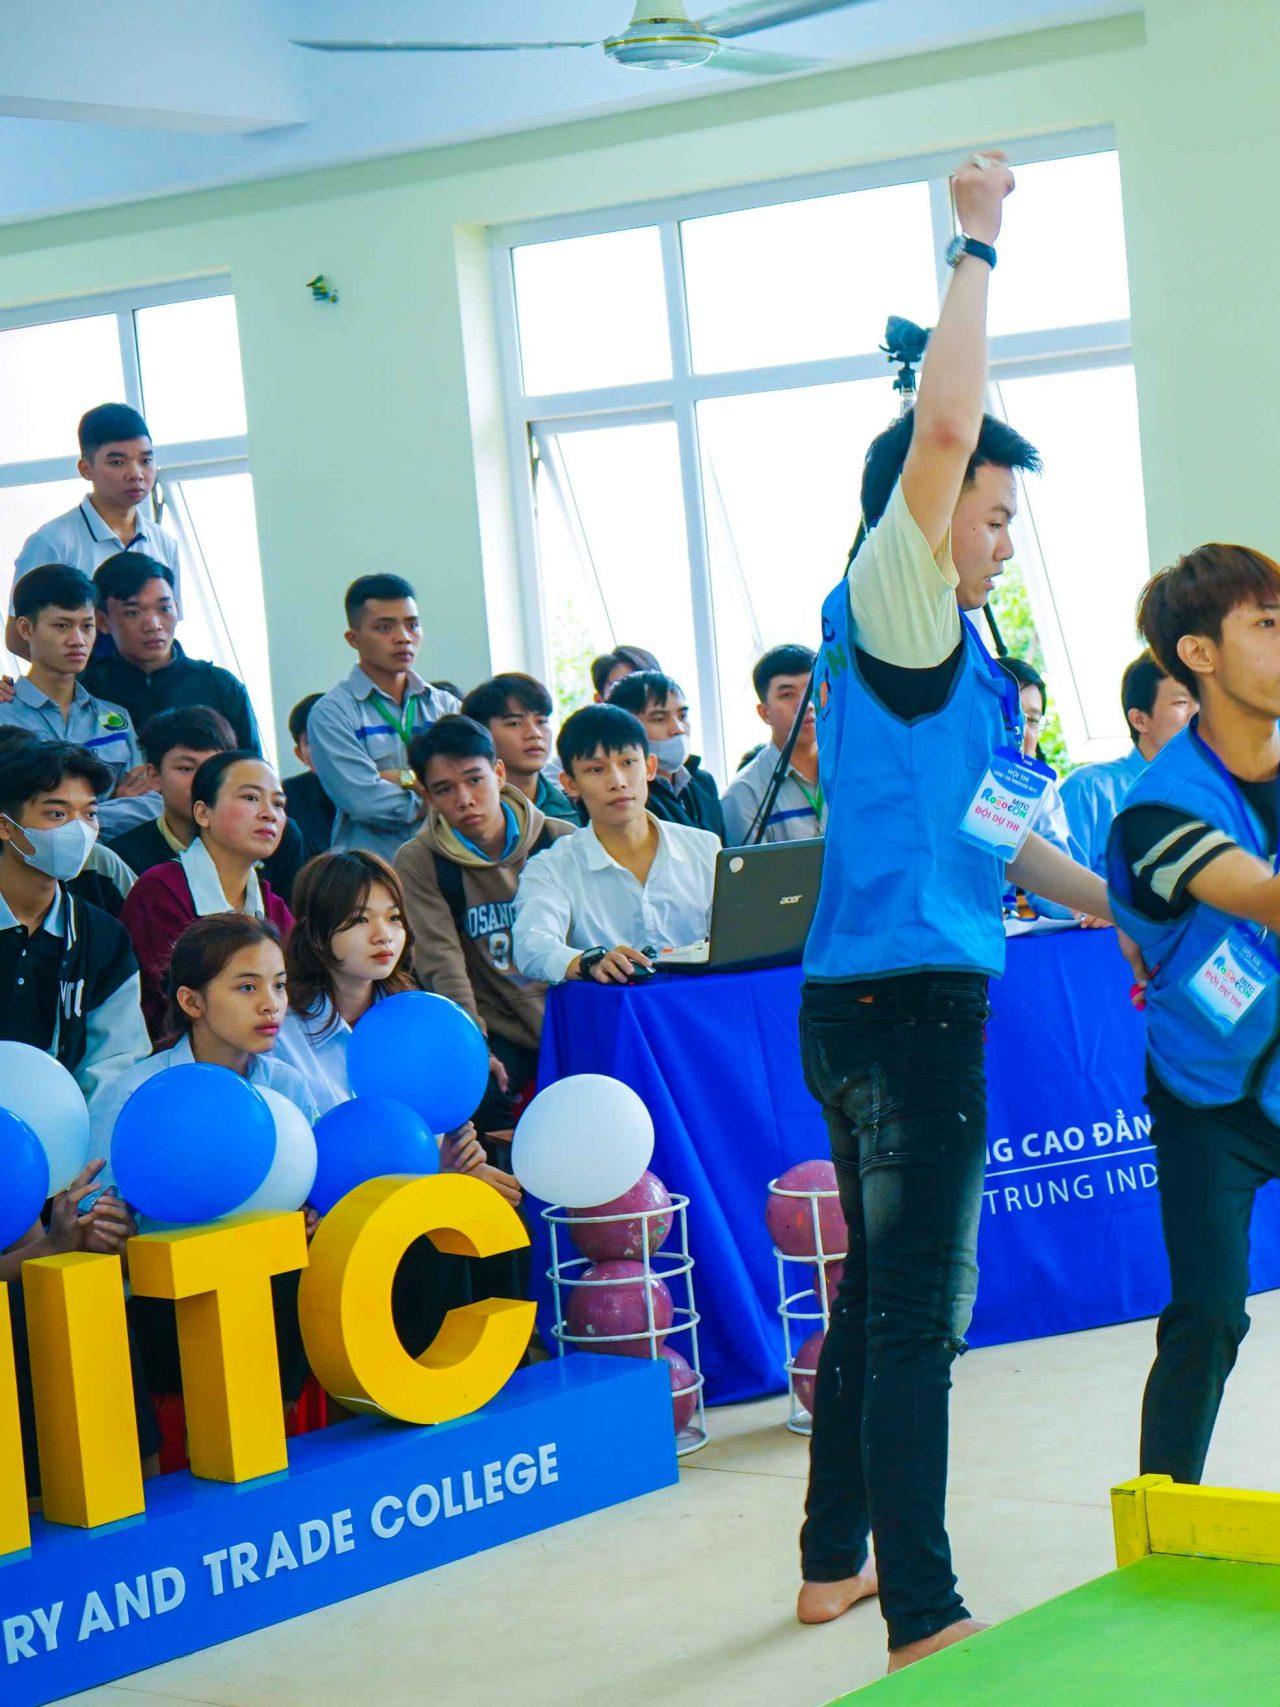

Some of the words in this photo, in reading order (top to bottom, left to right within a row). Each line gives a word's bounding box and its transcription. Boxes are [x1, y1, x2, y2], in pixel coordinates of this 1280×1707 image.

[974, 805, 991, 819] ĐỘI
[992, 814, 1005, 825] DỰ
[1006, 820, 1020, 832] THI
[779, 894, 802, 905] acer
[986, 1138, 1014, 1165] G
[1021, 1126, 1085, 1158] CAO
[983, 1174, 1094, 1215] TRUNG
[1106, 1163, 1159, 1195] IND
[2, 1600, 64, 1665] RY
[77, 1566, 187, 1642] AND
[203, 1508, 355, 1596] TRADE
[370, 1442, 559, 1539] COLLEGE
